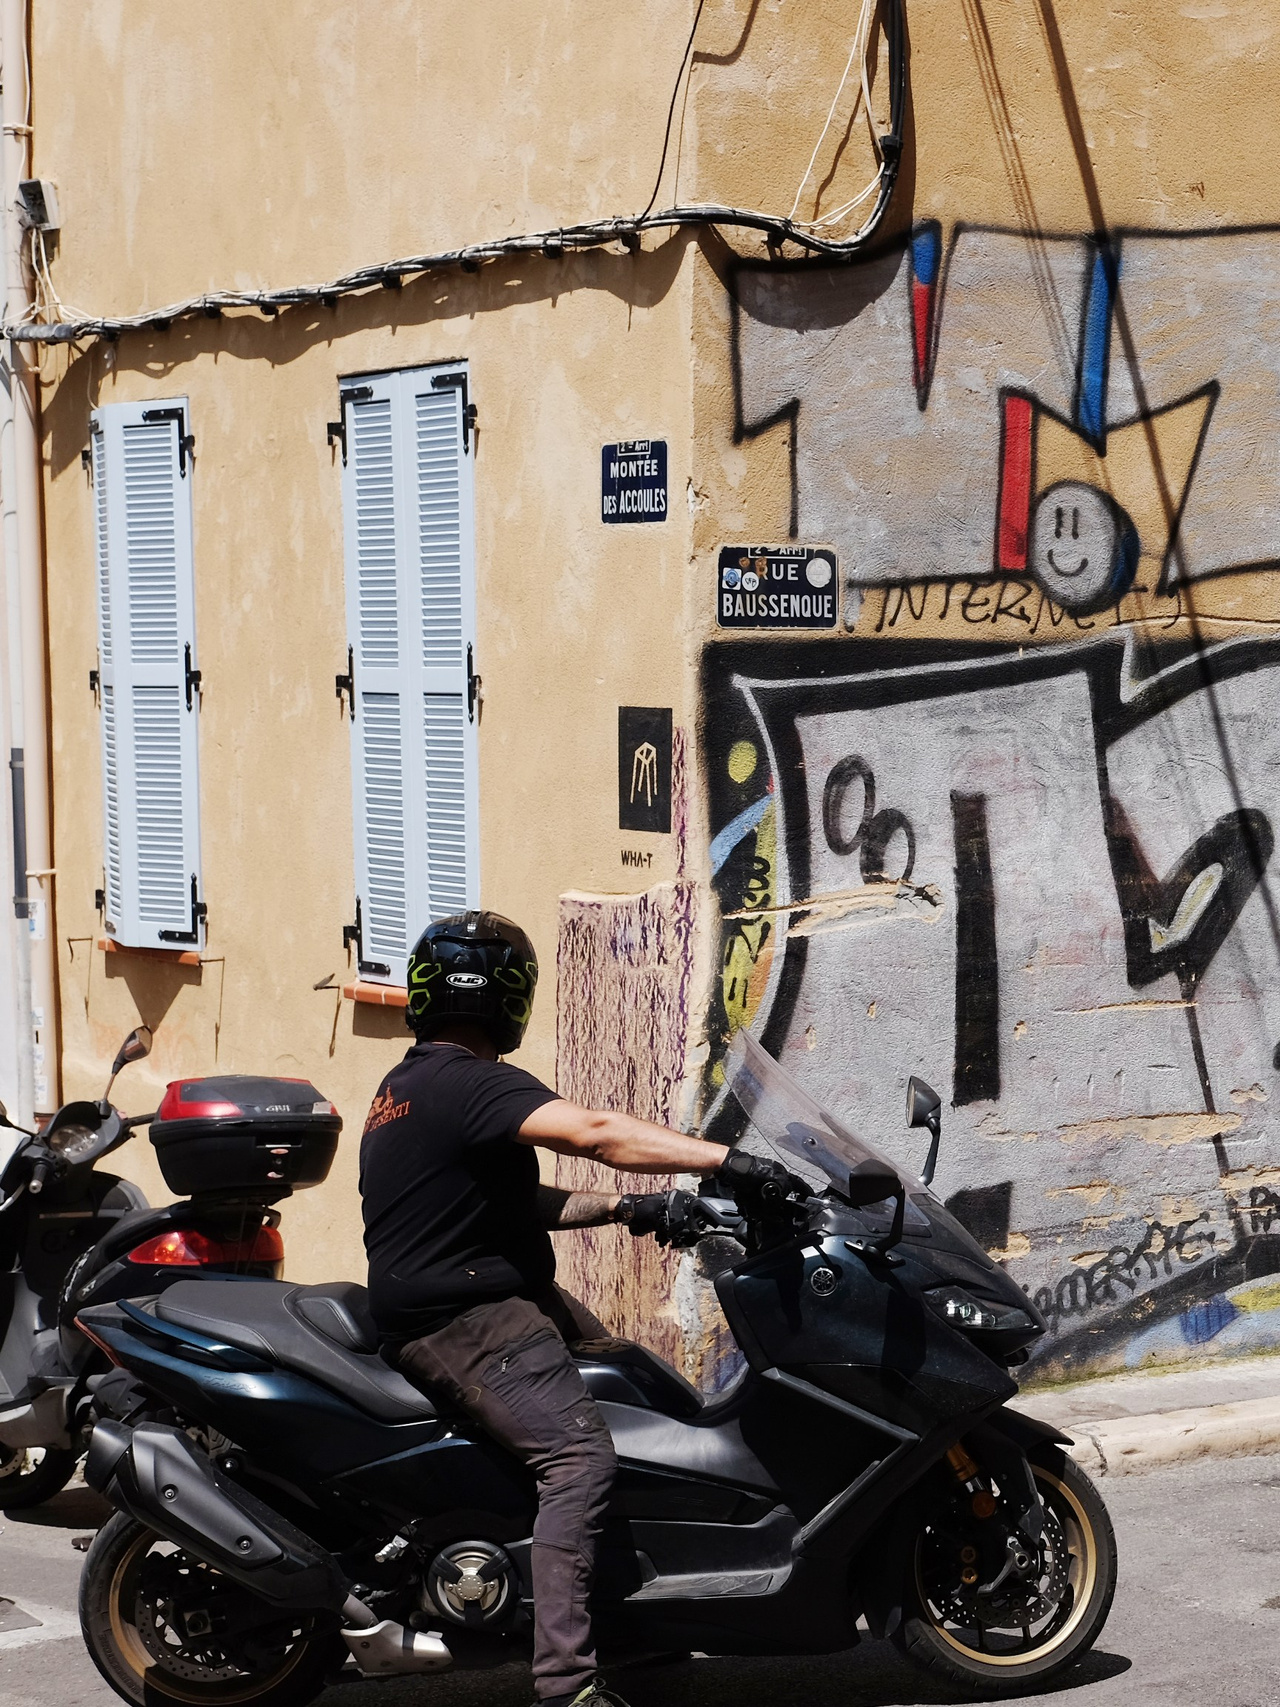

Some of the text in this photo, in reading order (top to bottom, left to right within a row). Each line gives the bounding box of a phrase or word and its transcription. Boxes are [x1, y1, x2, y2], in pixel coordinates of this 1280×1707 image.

[609, 454, 659, 479] MONTÉE
[603, 488, 666, 515] DES ACCOULES
[722, 593, 833, 618] BAUSSENQUE
[452, 973, 481, 984] HJC
